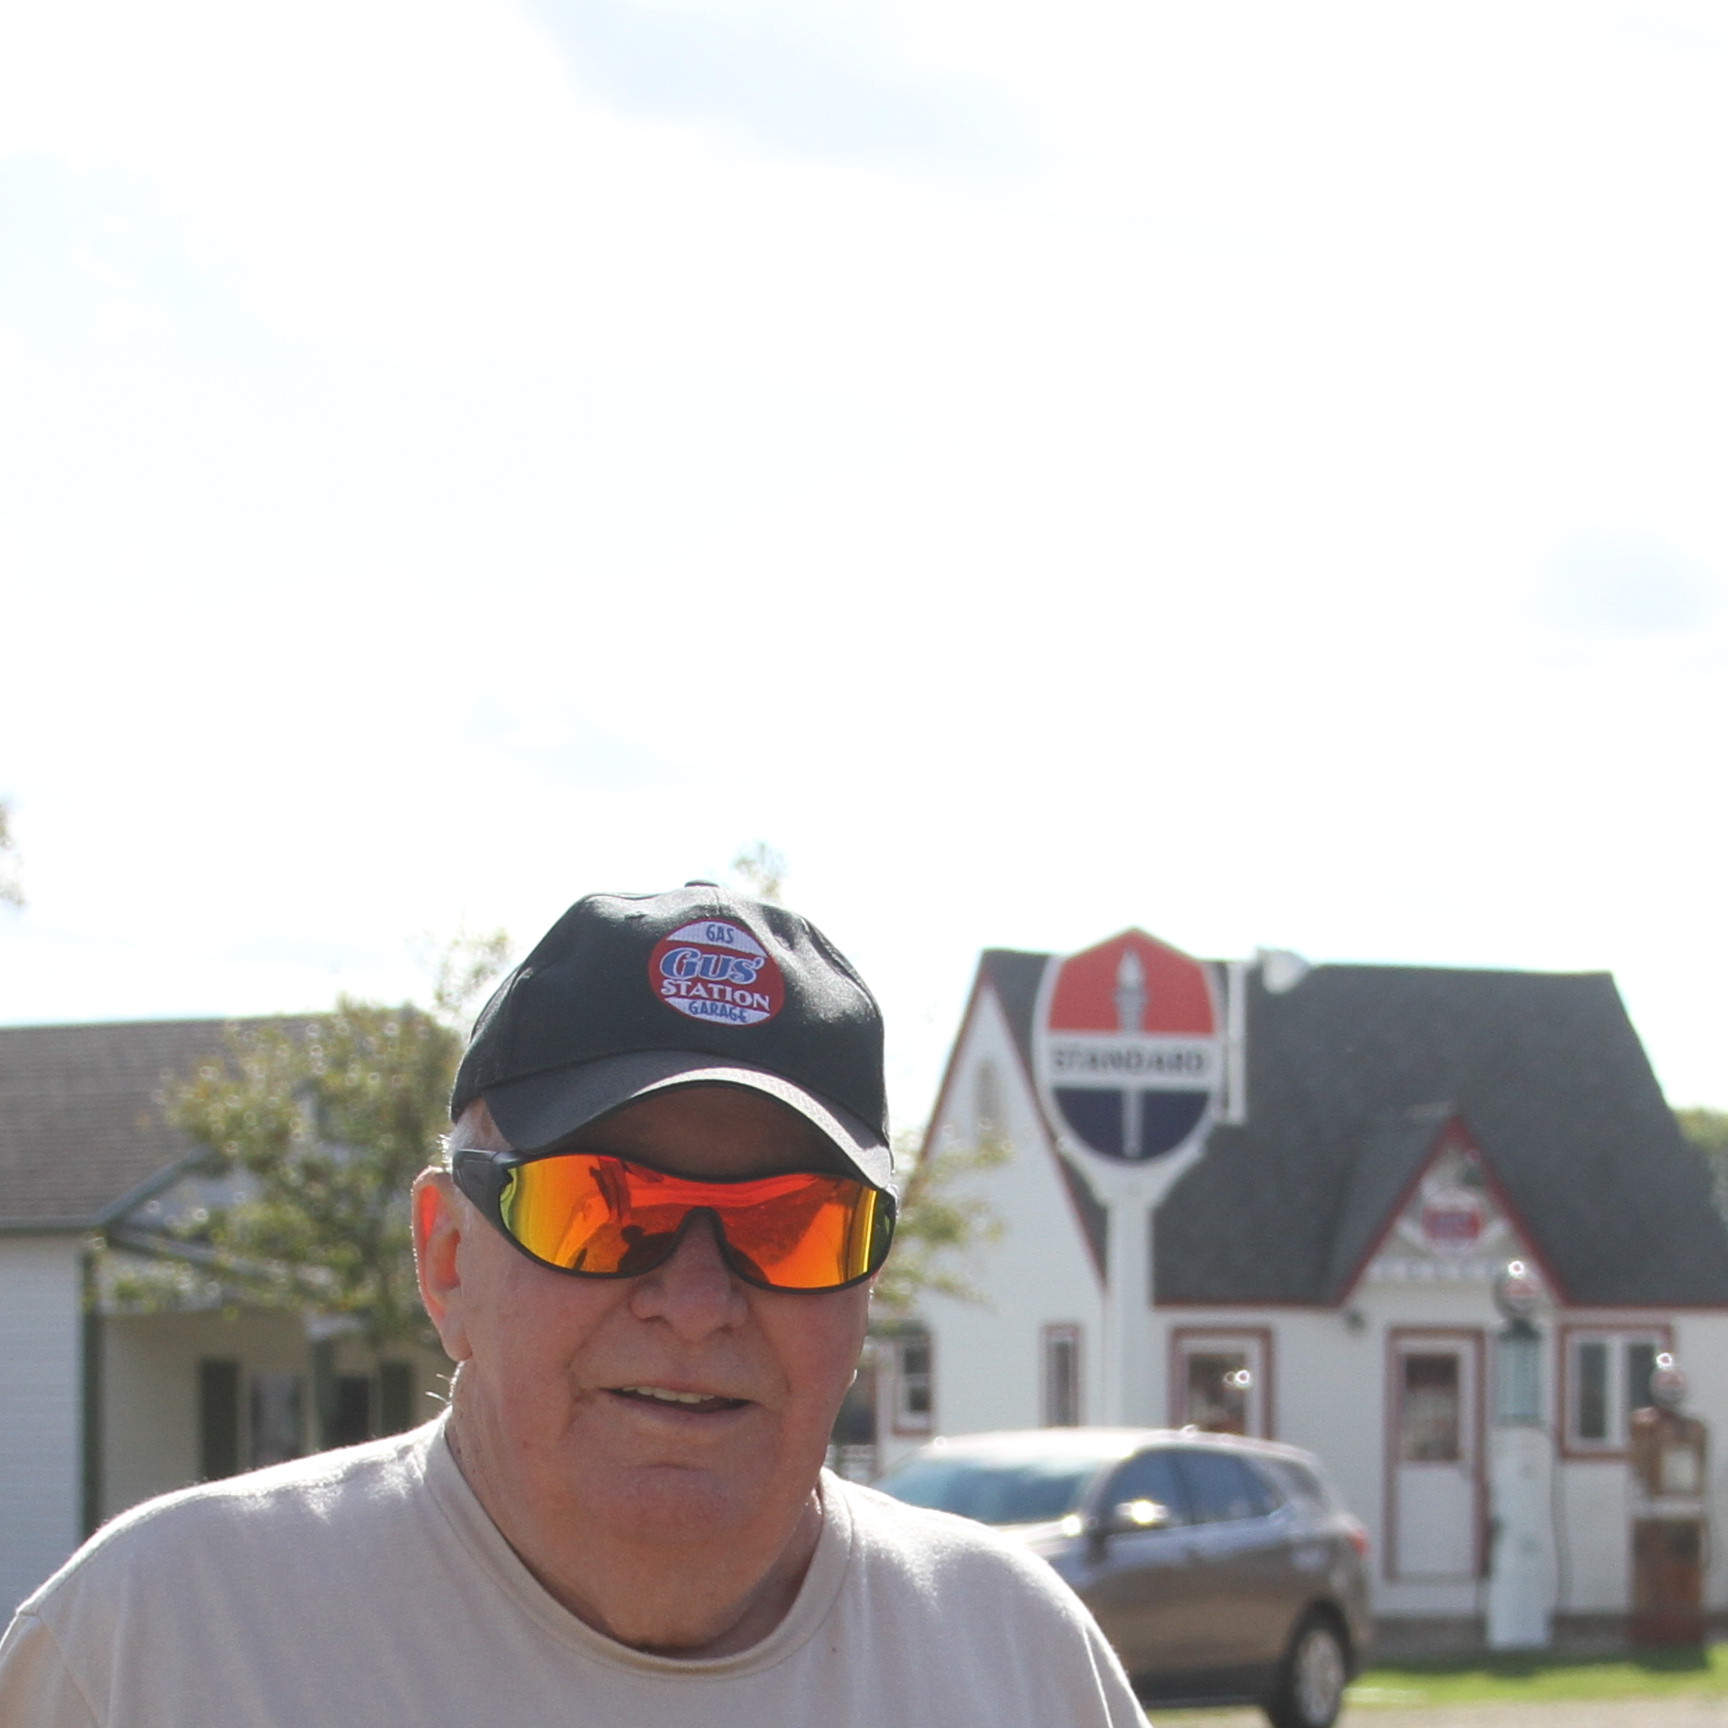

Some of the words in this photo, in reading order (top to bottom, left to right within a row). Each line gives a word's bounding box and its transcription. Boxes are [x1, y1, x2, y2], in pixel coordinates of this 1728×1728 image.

[706, 924, 735, 944] GAS
[660, 979, 770, 1011] STATION
[689, 1001, 747, 1023] GARAGE
[1053, 1047, 1206, 1074] STANDARD
